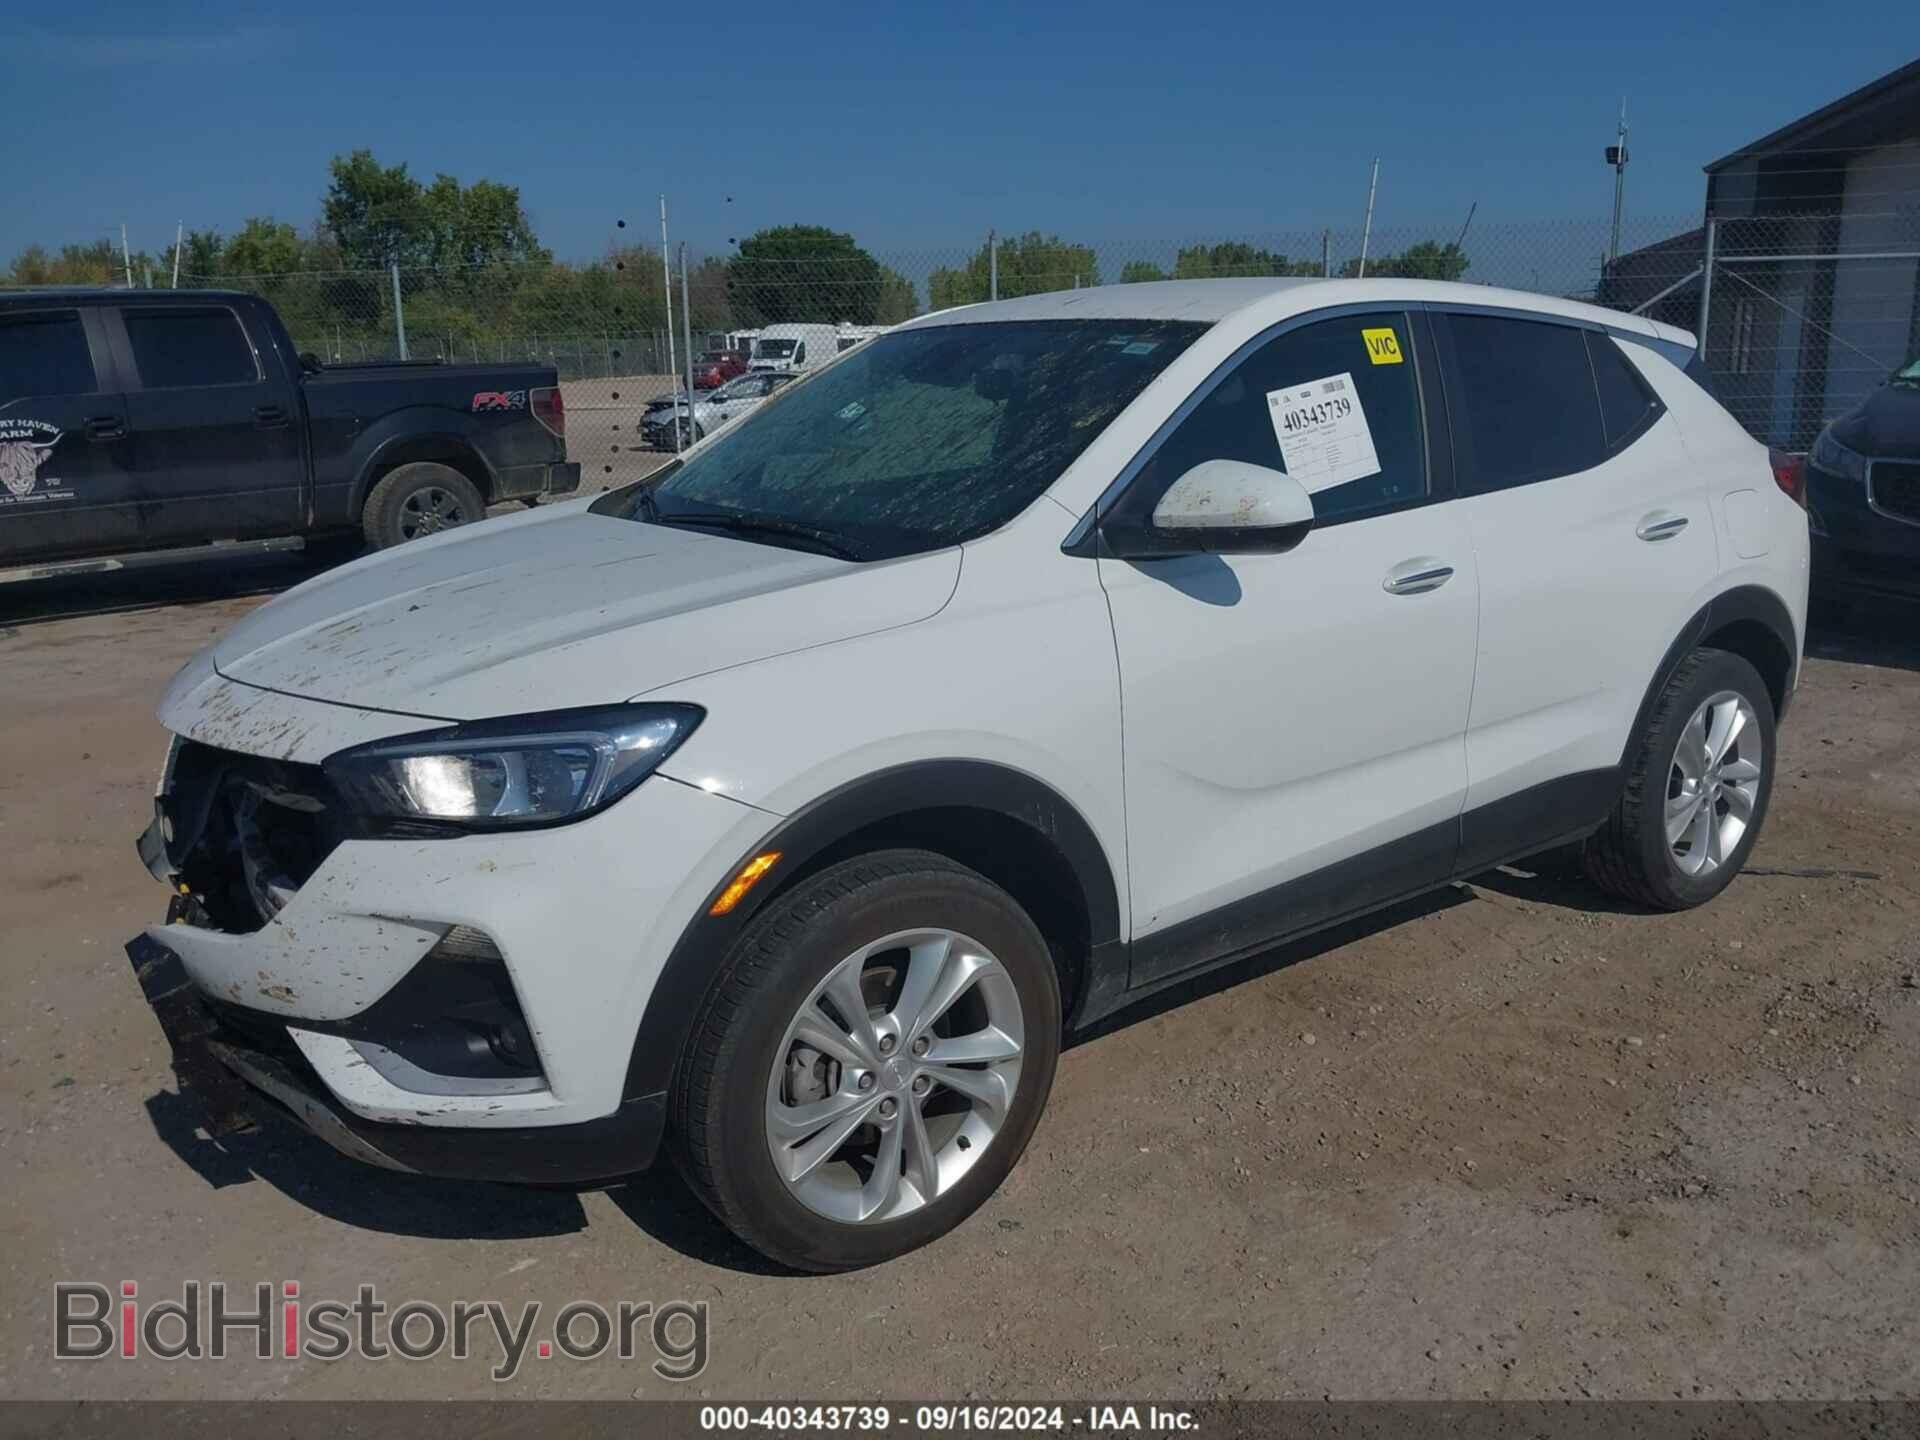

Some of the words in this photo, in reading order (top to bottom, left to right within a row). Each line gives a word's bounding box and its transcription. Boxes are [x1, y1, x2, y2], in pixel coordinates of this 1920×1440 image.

[1367, 336, 1397, 355] VIC
[472, 390, 525, 409] FX4
[1284, 398, 1351, 432] 40343739
[17, 419, 60, 434] HAVEN
